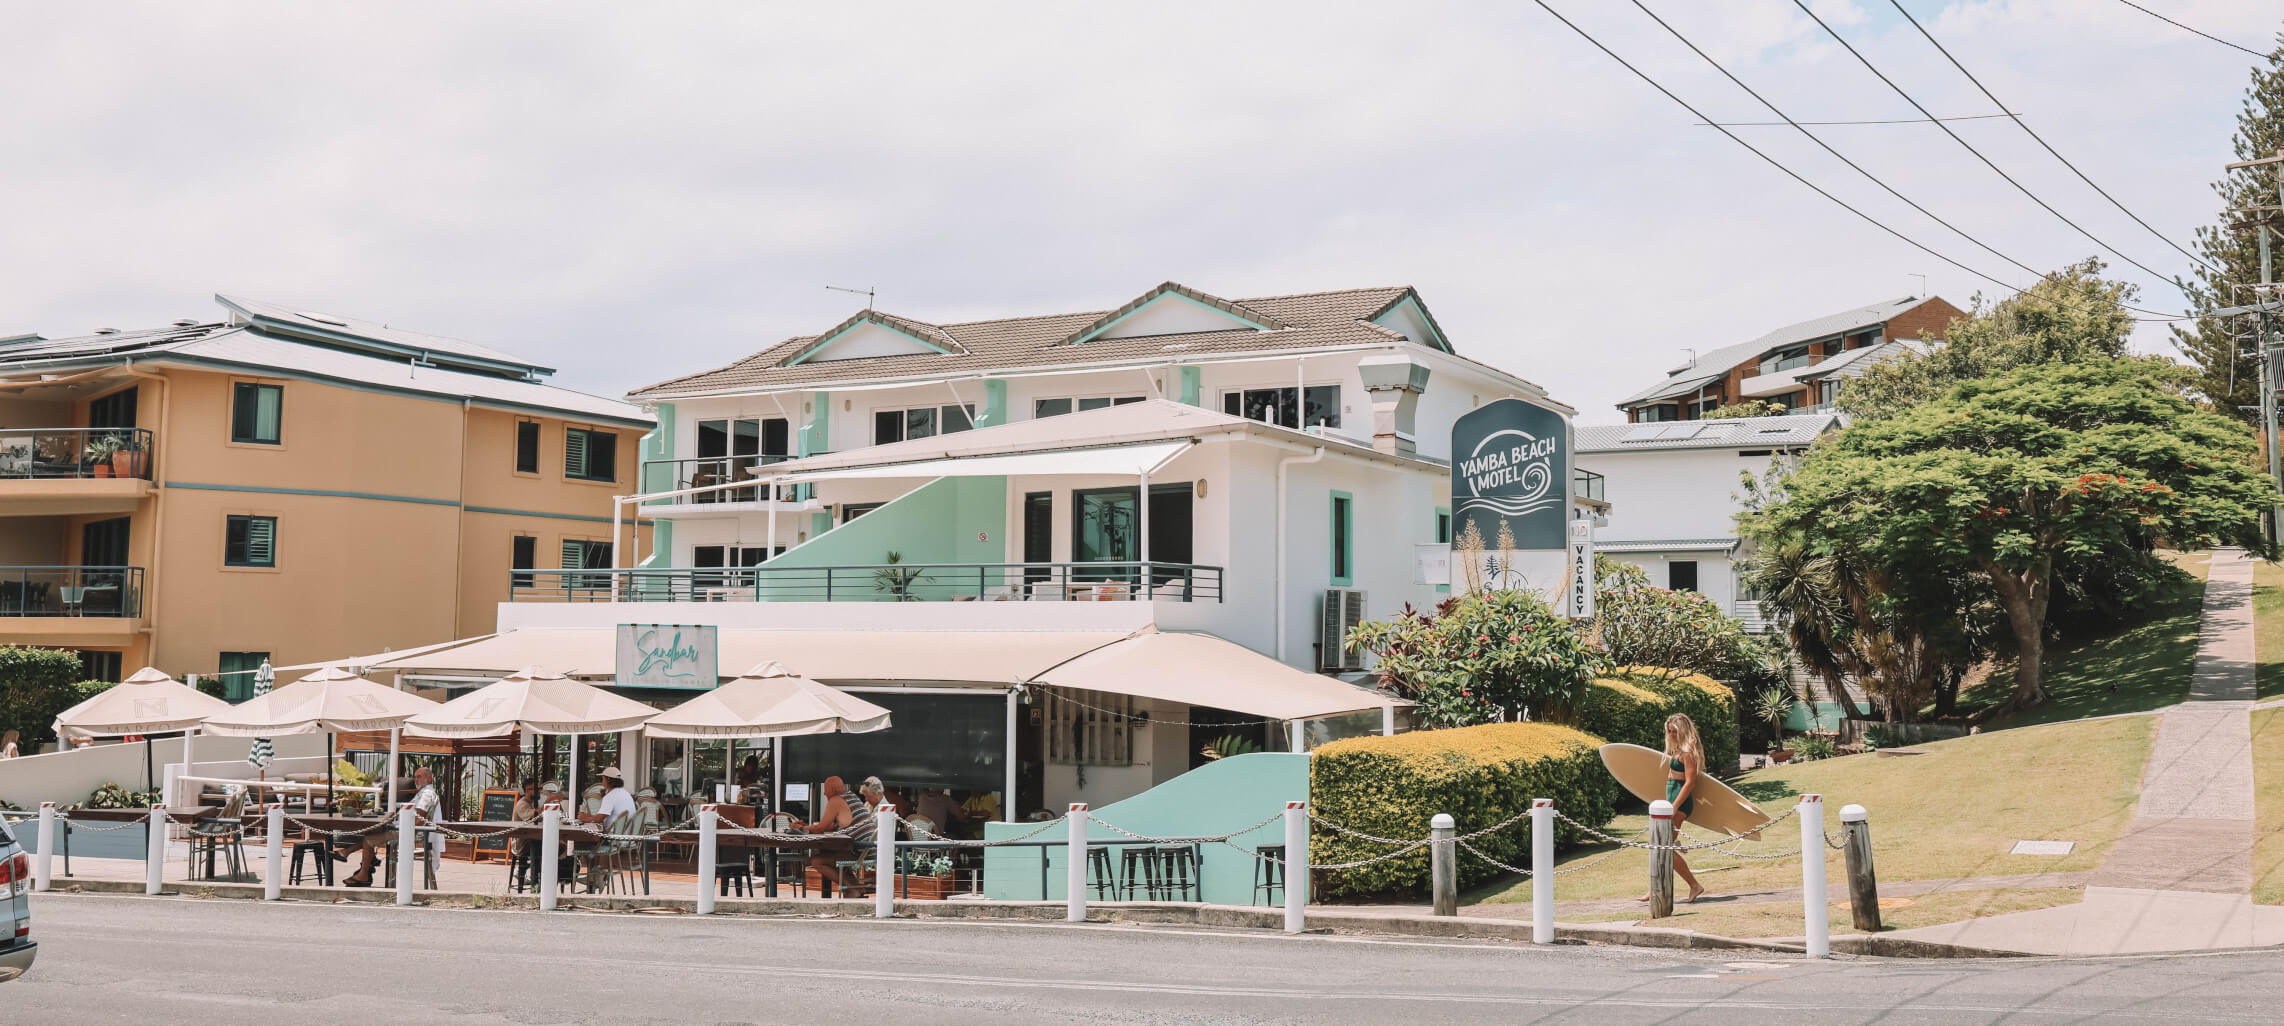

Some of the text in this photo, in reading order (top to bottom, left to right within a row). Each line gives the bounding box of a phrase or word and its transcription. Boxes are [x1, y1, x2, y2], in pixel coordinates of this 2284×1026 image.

[1459, 436, 1556, 478] YAMBA BEACH
[1477, 465, 1522, 492] MOTEL
[1575, 545, 1585, 615] VACANCY
[637, 630, 699, 672] Sandbar
[693, 725, 762, 738] MARCO
